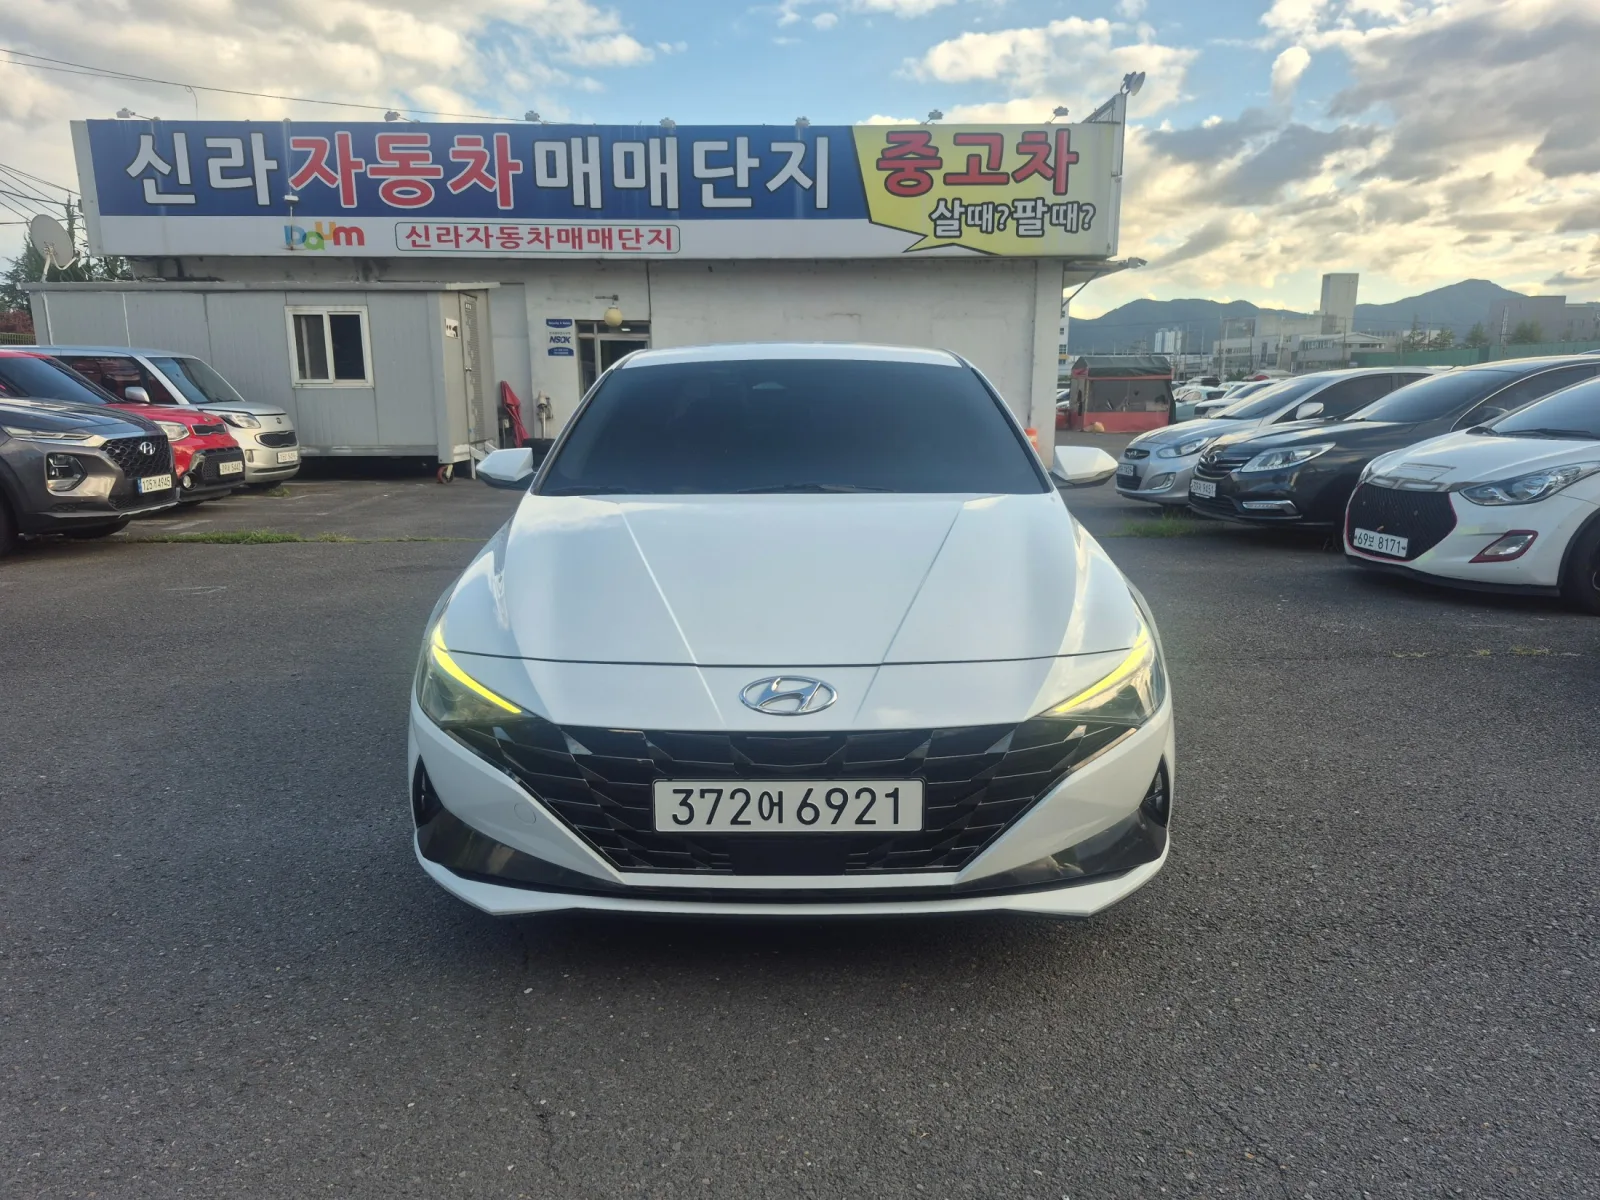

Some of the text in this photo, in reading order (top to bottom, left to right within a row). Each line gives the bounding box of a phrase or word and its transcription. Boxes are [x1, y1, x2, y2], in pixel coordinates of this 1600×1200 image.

[876, 128, 1079, 197] 중고차
[405, 225, 674, 251] 신라자동차매매단지
[1377, 536, 1401, 554] 8171
[671, 787, 900, 825] 372어 6921
